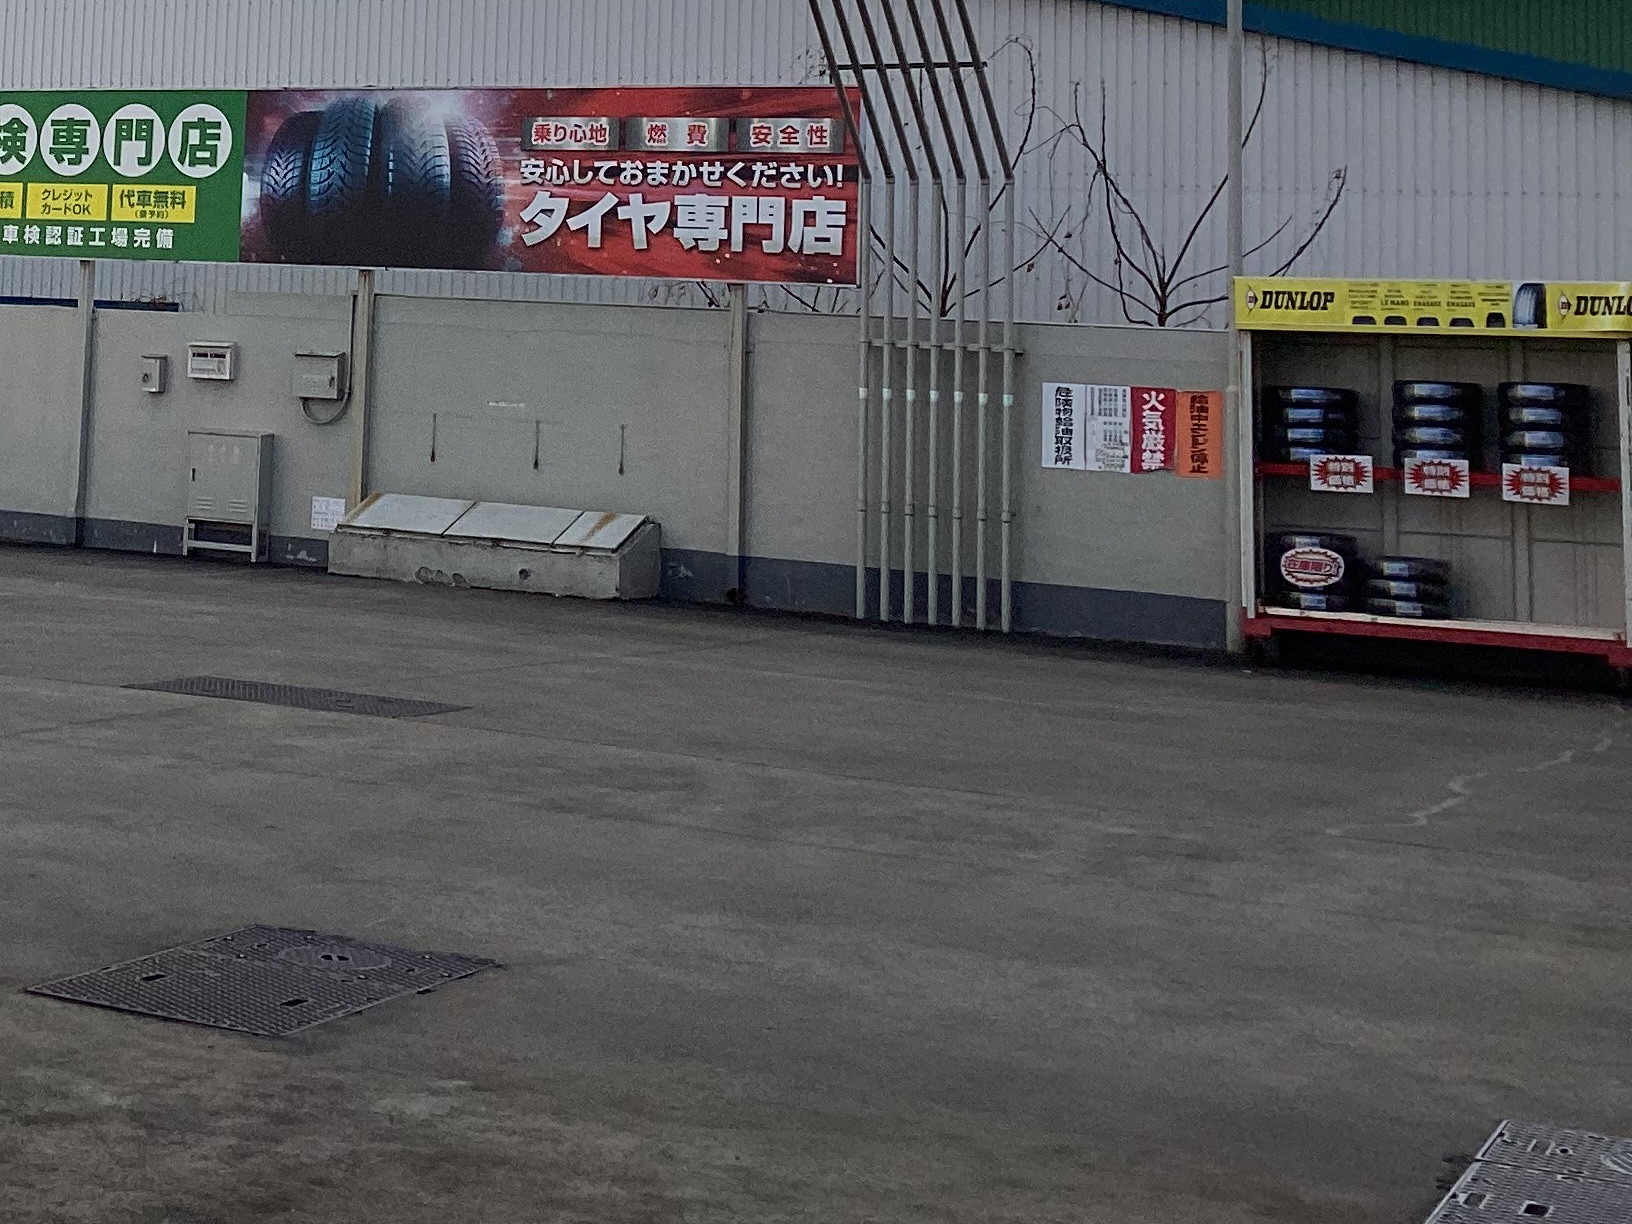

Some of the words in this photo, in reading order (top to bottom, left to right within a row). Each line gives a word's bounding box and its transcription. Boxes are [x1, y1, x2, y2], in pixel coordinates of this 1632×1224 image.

[531, 121, 609, 145] 乗り心地
[646, 121, 708, 146] 燃費
[749, 124, 830, 147] 安全性
[519, 158, 844, 188] 安心しておまかせください!
[41, 188, 93, 201] クレジット
[119, 190, 186, 210] 代車無料
[41, 203, 91, 216] カードOK
[519, 191, 847, 257] タイヤ専門店
[1259, 290, 1335, 311] DUNLOP
[1141, 390, 1166, 470] 火気厳禁
